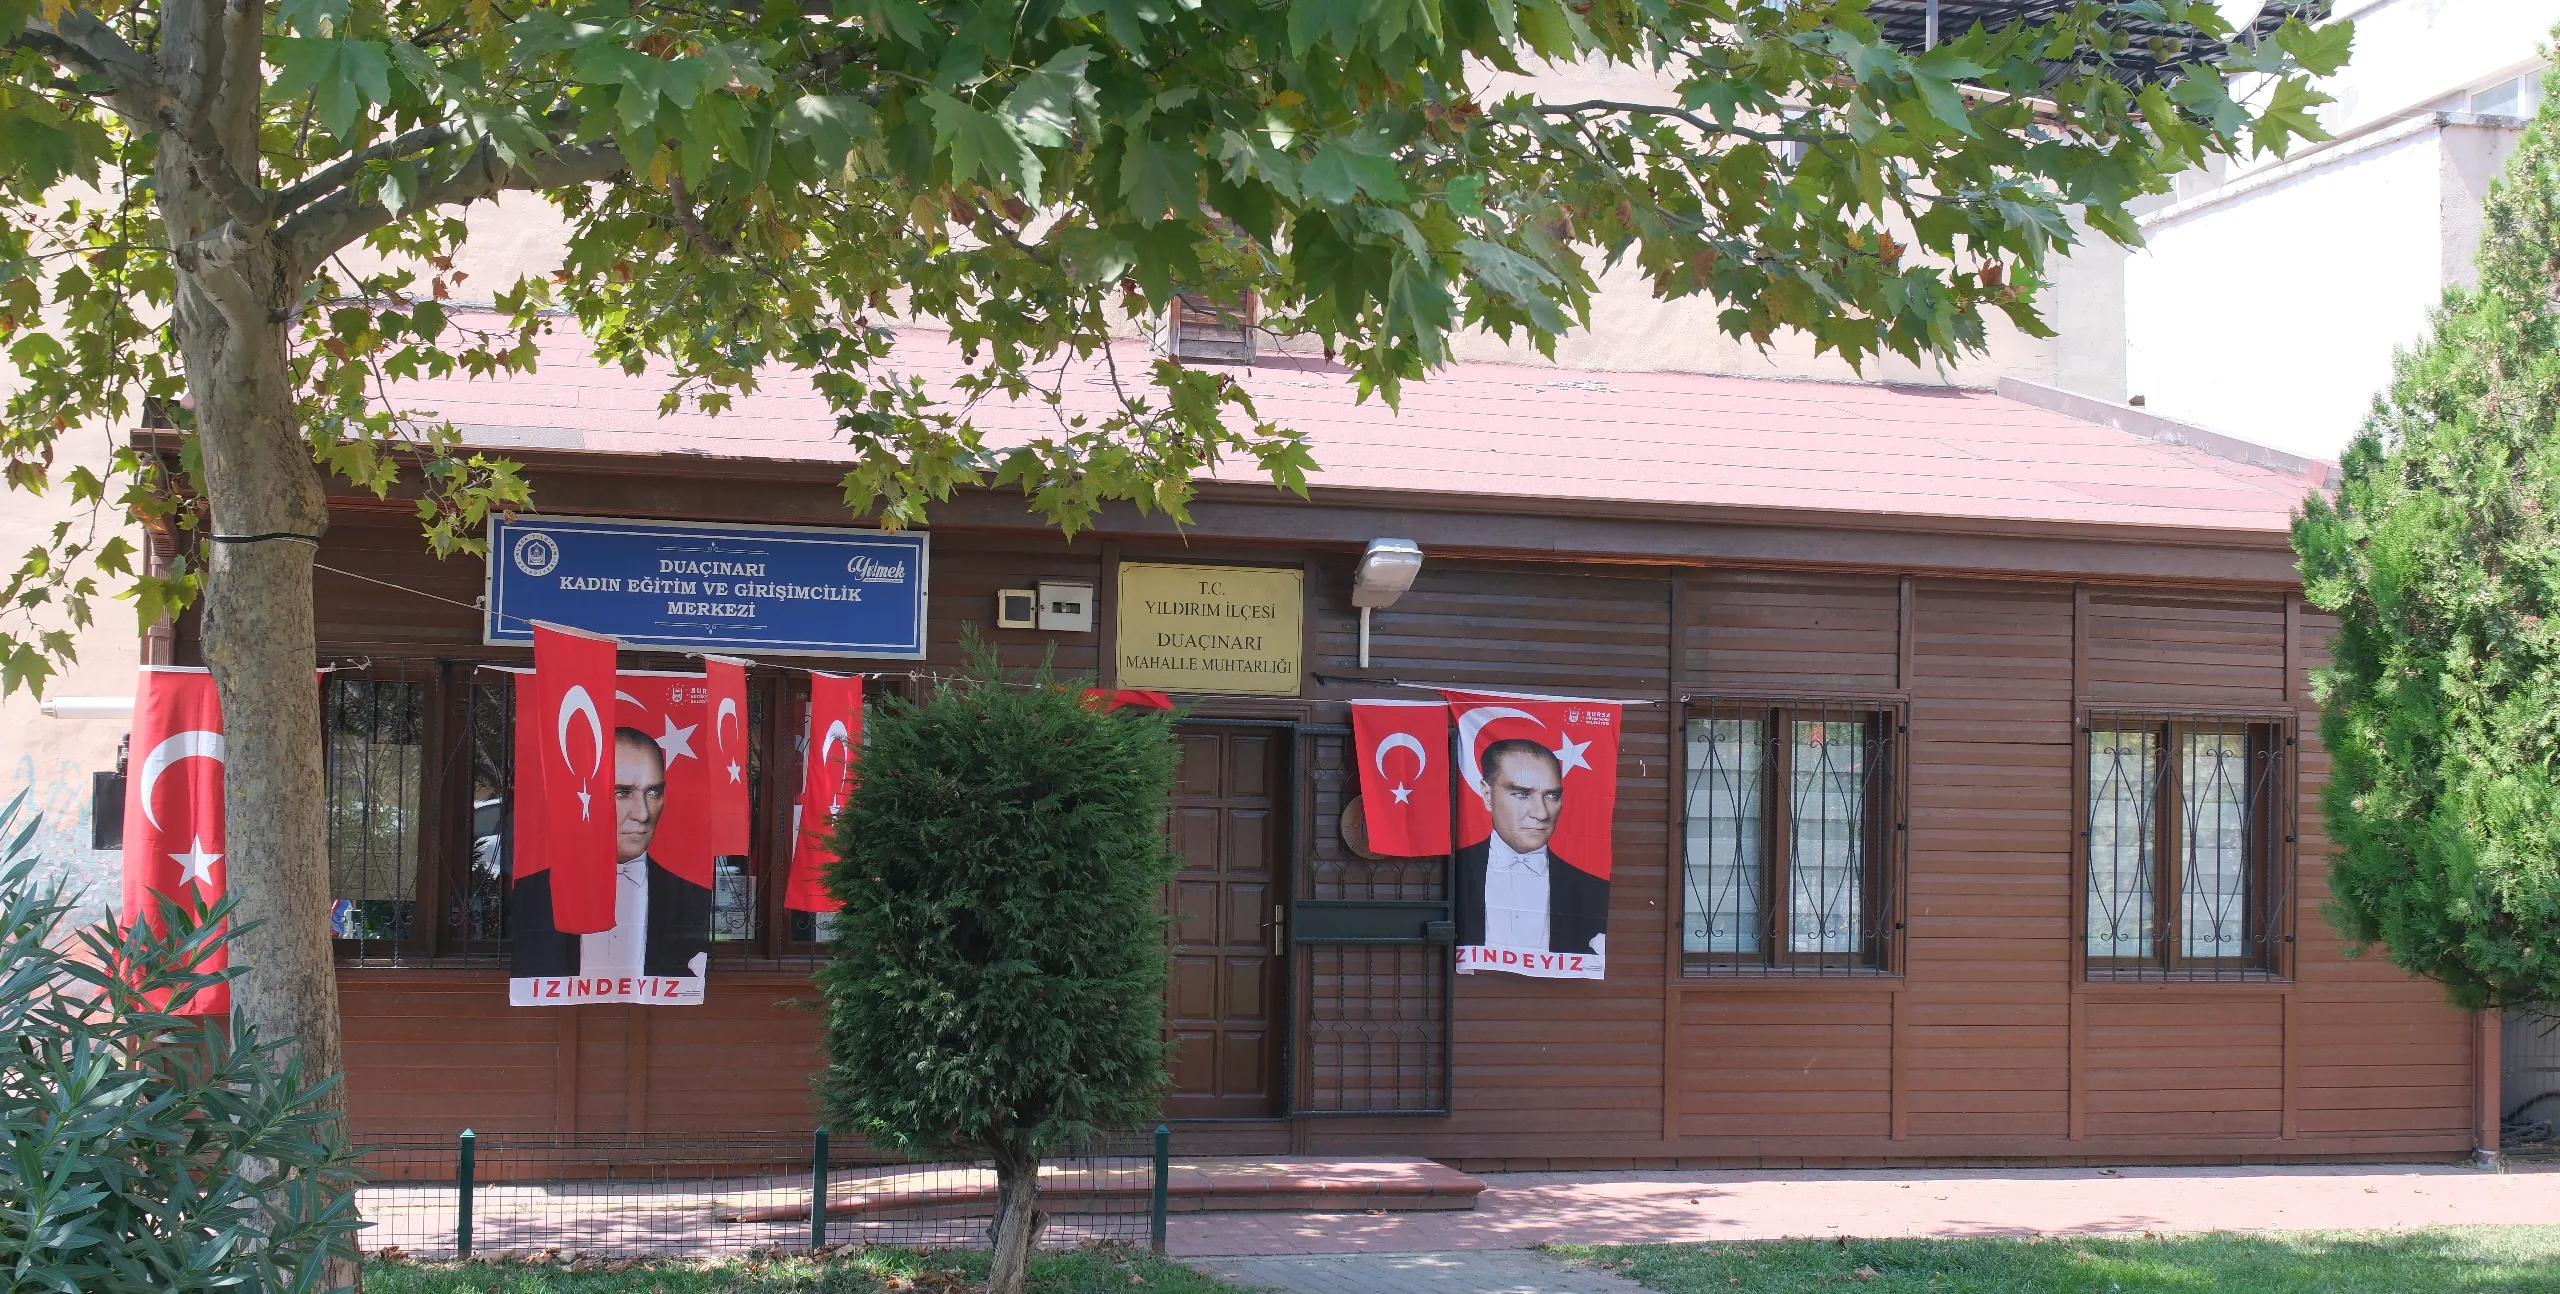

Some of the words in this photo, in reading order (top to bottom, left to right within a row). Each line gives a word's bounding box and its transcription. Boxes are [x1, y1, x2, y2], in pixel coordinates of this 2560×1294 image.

[659, 559, 766, 577] DUAÇINARI
[559, 576, 621, 591] KADIN
[627, 576, 697, 594] EĞİTİM
[703, 582, 728, 596] VE
[734, 581, 862, 602] GİRİŞİMCİLİK
[1198, 581, 1226, 596] T.C.
[667, 601, 756, 618] MERKEZİ
[1144, 600, 1221, 617] YILDIRIM
[1225, 601, 1276, 621] İLÇESİ
[1157, 632, 1263, 652] DUAÇINARI
[1126, 655, 1198, 670] MAHALLE
[1201, 658, 1292, 674] MUHTARLIĞI
[691, 687, 708, 695] BUR
[1455, 946, 1583, 972] ZİNDEYİZ
[532, 977, 681, 998] İZİNDEYİZ
